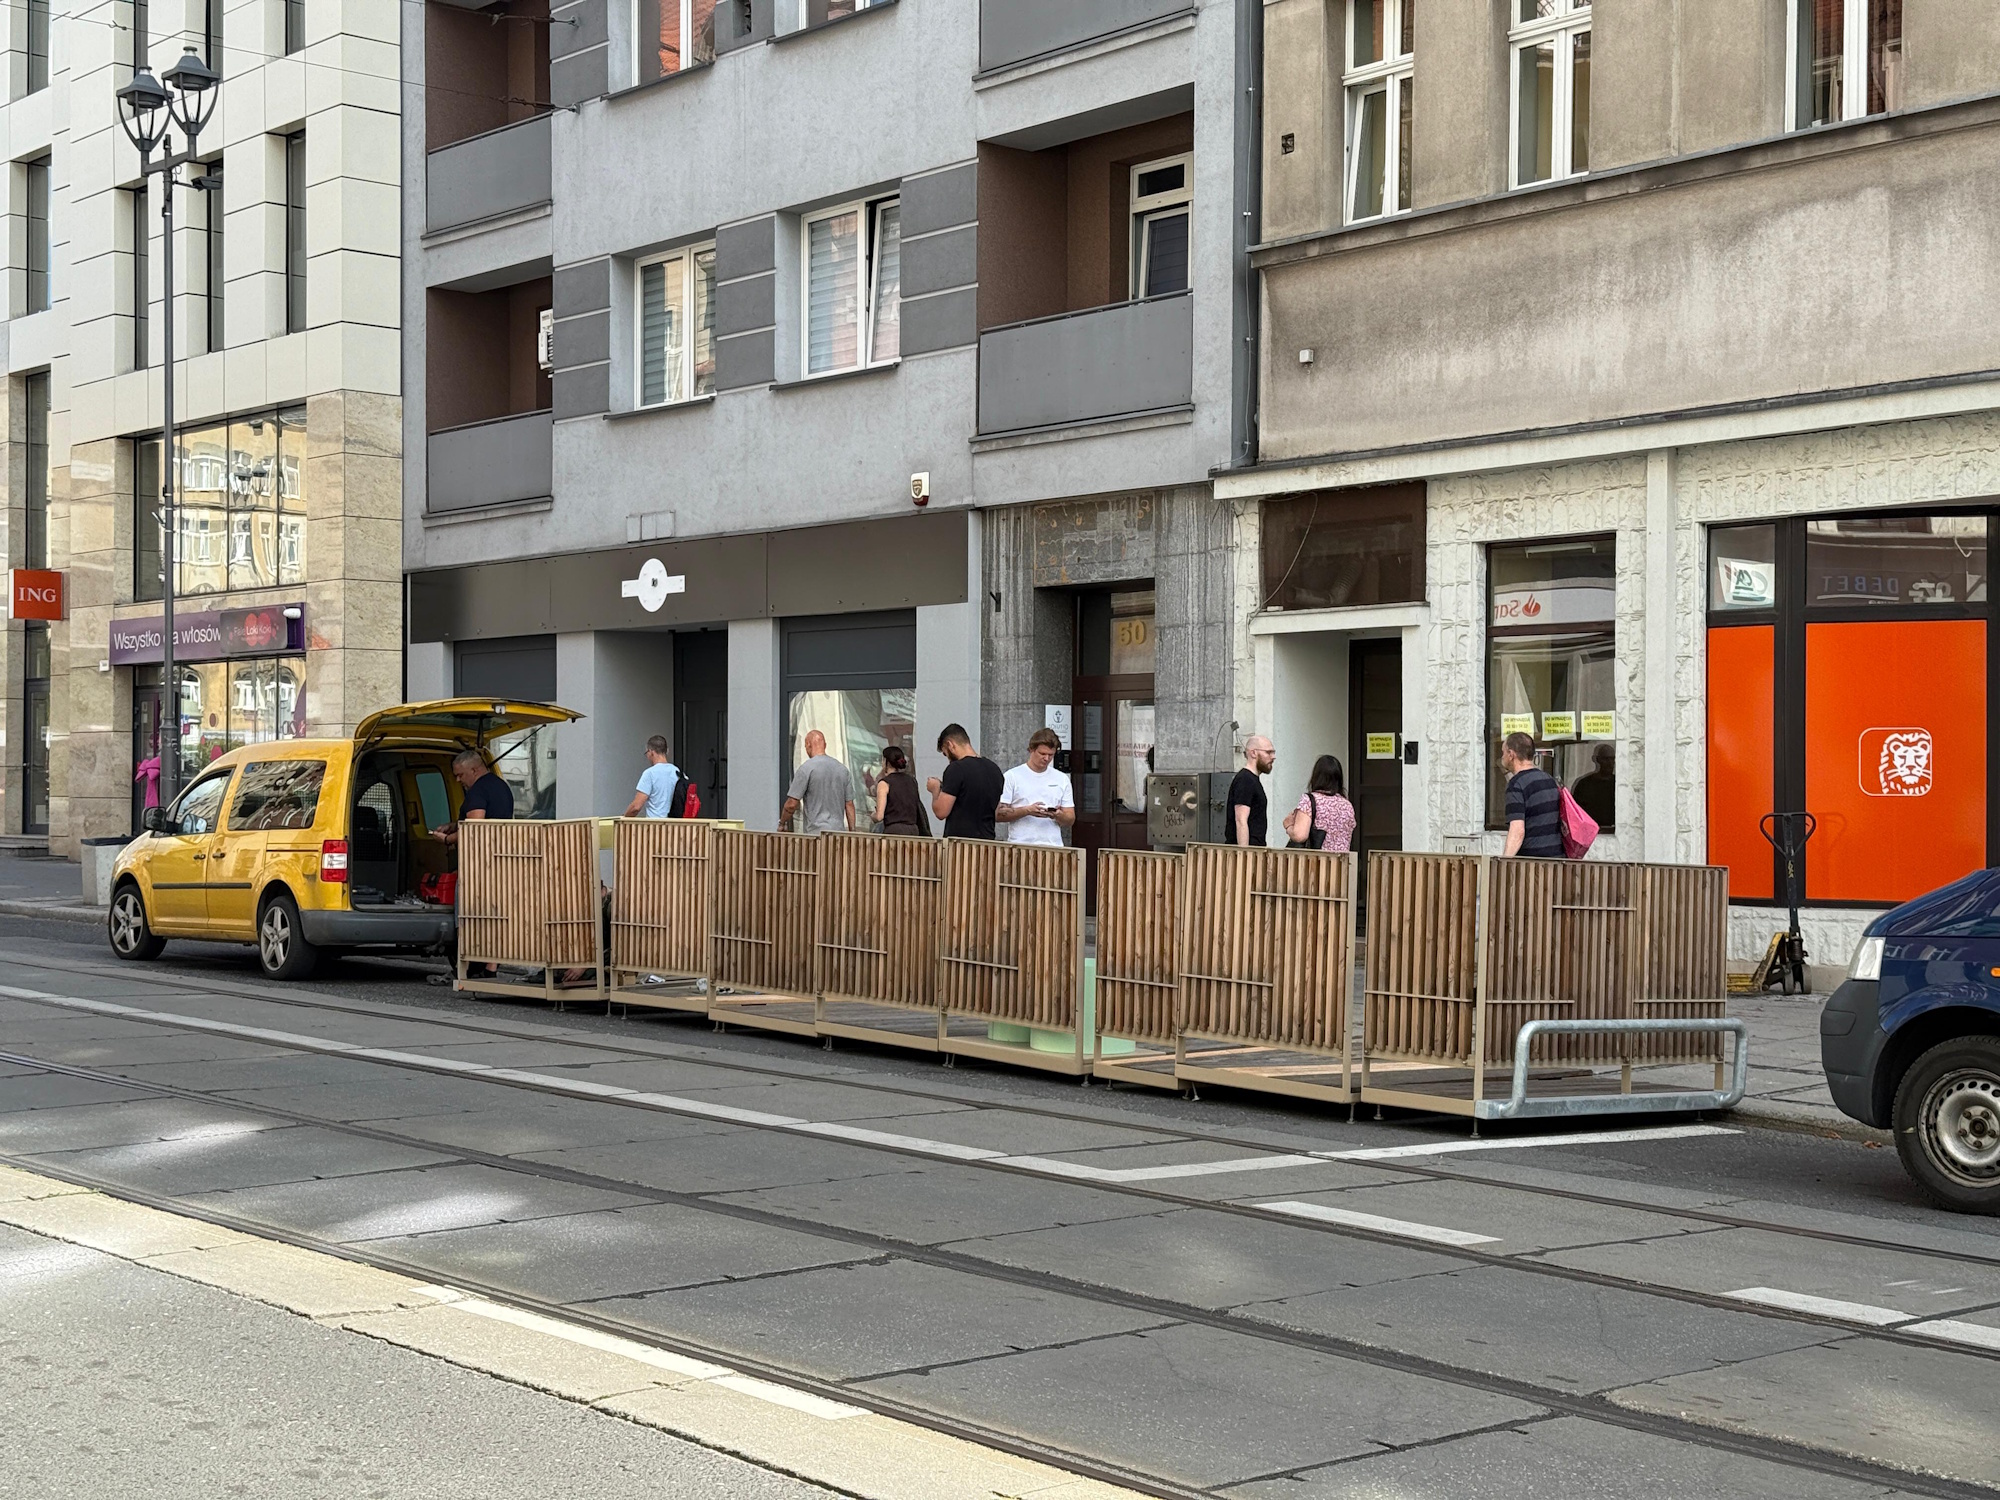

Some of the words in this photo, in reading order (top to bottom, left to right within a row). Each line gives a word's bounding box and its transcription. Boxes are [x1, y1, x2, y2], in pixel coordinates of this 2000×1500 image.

[18, 586, 57, 603] ING
[113, 630, 160, 653] Wszystko
[181, 623, 221, 644] włosów
[1118, 619, 1147, 646] 50
